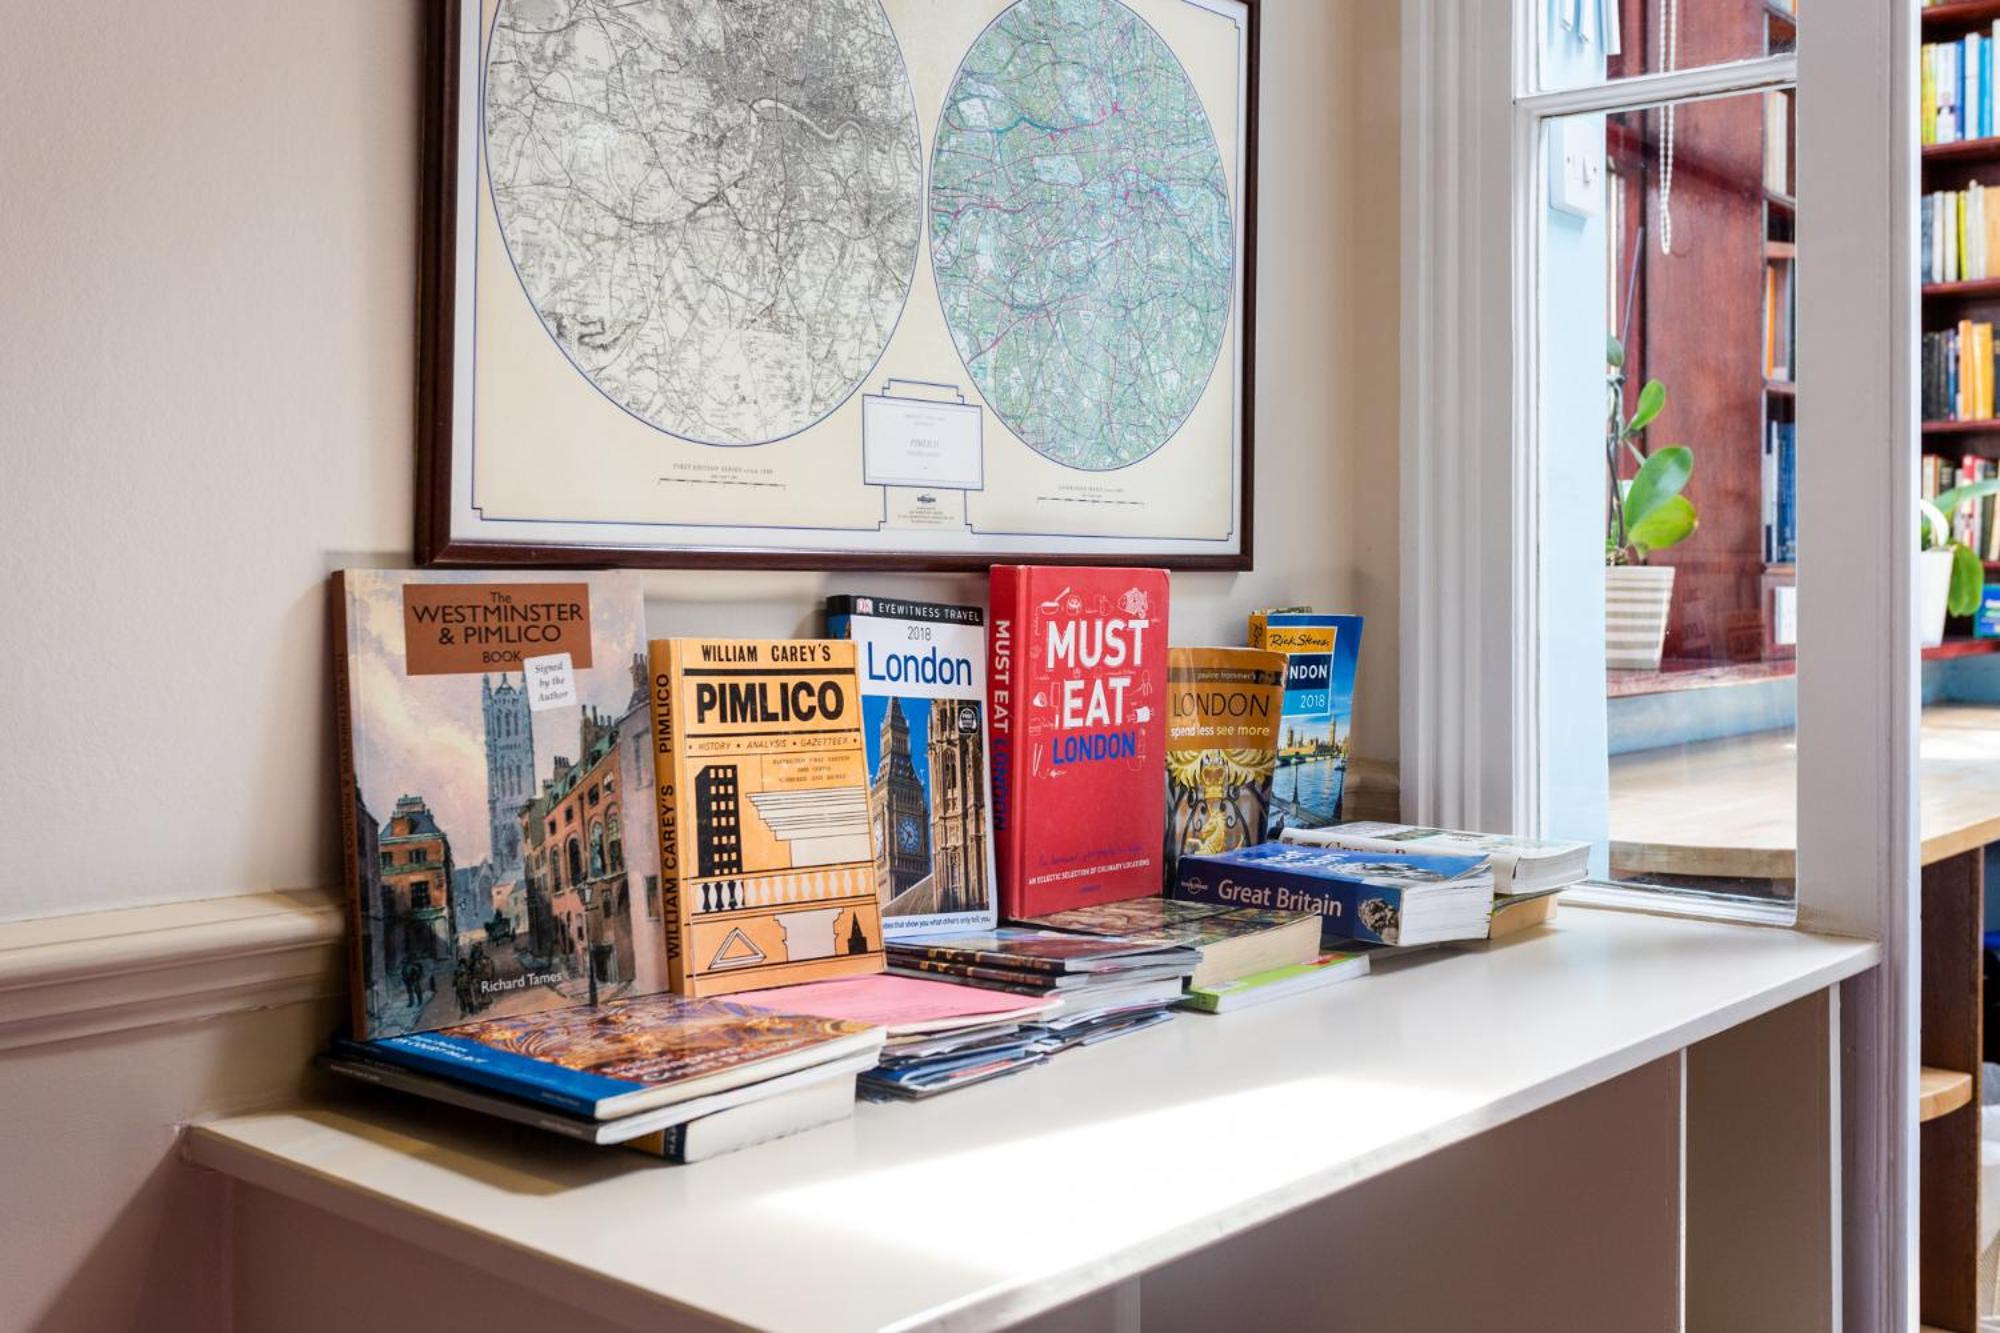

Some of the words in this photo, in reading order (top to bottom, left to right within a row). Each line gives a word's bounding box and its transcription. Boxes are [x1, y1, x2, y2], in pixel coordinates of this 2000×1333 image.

[490, 592, 512, 604] The
[412, 603, 585, 624] WESTMINSTER
[879, 602, 940, 618] EYEWITNESS
[944, 608, 980, 622] TRAVEL
[438, 627, 455, 645] &
[464, 625, 562, 644] PIMLICO
[907, 625, 932, 641] 2018
[1269, 633, 1296, 647] Rick
[702, 644, 758, 662] WILLIAM
[772, 643, 832, 662] CAREY'S
[994, 620, 1011, 686] MUST
[1047, 618, 1150, 670] MUST
[482, 651, 523, 664] BOOK
[868, 641, 972, 686] London
[535, 661, 563, 676] Signed
[1290, 664, 1328, 680] NDON
[539, 678, 550, 689] by
[552, 676, 566, 685] the
[537, 691, 568, 702] Author
[696, 680, 844, 724] PIMLICO
[1063, 676, 1132, 730] EAT
[1174, 692, 1270, 718] LONDON
[1300, 694, 1326, 709] 2018
[656, 674, 673, 754] PIMLICO
[994, 691, 1009, 734] EAT
[1171, 726, 1196, 740] spend
[1197, 726, 1214, 736] less
[1216, 726, 1234, 736] see
[1237, 726, 1270, 736] more
[698, 742, 731, 750] HISTORY
[746, 739, 786, 749] ANALYSIS
[800, 737, 848, 747] GAZETTEER
[1052, 728, 1136, 766] LONDON
[661, 784, 677, 870] CAREY'S
[1062, 868, 1090, 880] SELECTION
[1218, 879, 1272, 906] Great
[1276, 886, 1342, 918] Britain
[664, 876, 682, 960] WILLIAM
[481, 976, 525, 993] Richard
[527, 973, 562, 986] Tames
